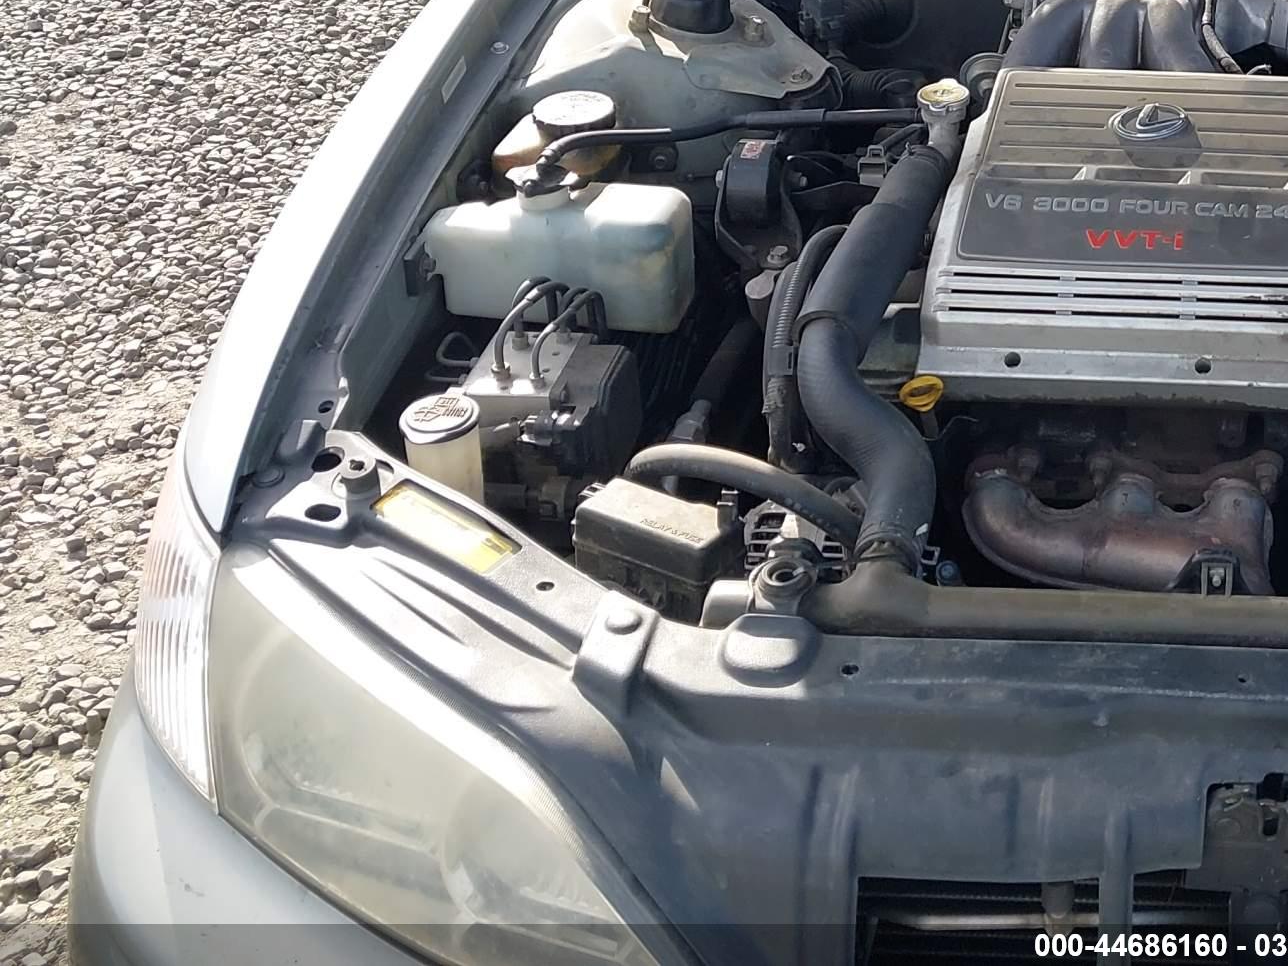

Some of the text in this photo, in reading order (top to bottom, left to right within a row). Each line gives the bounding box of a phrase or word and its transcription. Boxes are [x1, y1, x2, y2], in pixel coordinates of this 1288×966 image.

[984, 192, 1022, 210] V6
[1032, 192, 1110, 214] 3000
[1119, 197, 1190, 217] FOUR
[1194, 201, 1249, 219] CAM
[1085, 228, 1185, 251] VVT-i
